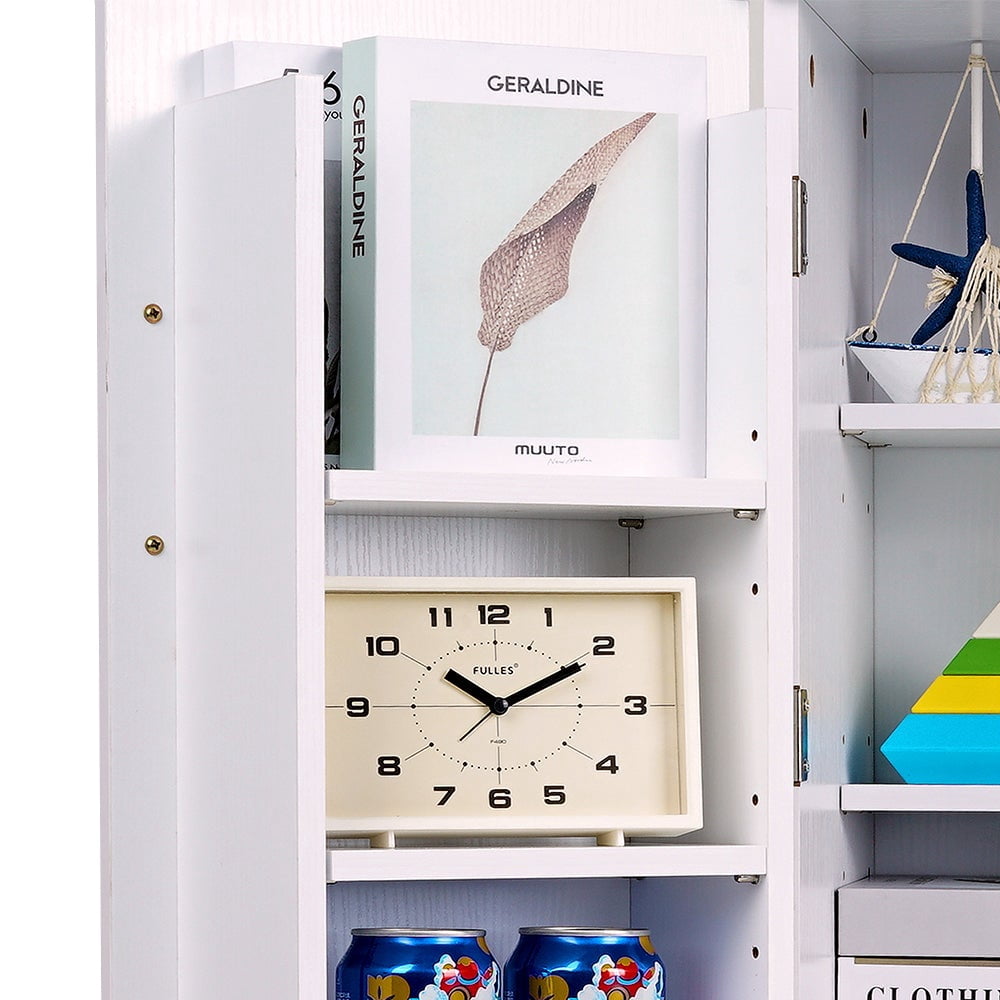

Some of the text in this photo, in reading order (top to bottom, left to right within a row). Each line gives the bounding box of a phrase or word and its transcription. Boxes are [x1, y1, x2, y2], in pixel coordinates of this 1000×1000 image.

[487, 75, 604, 97] GERALDINE
[352, 95, 366, 258] GERALDINE
[515, 444, 578, 456] MUUTO
[428, 607, 453, 627] 11
[478, 604, 510, 625] 12
[544, 607, 553, 627] 1
[366, 637, 400, 656] 10
[592, 636, 615, 656] 2
[473, 666, 514, 675] FULLES
[346, 697, 370, 717] 9
[624, 695, 647, 715] 3
[377, 756, 401, 776] 8
[596, 755, 619, 774] 4
[433, 786, 455, 806] 7
[488, 788, 511, 809] 6
[544, 785, 566, 805] 5
